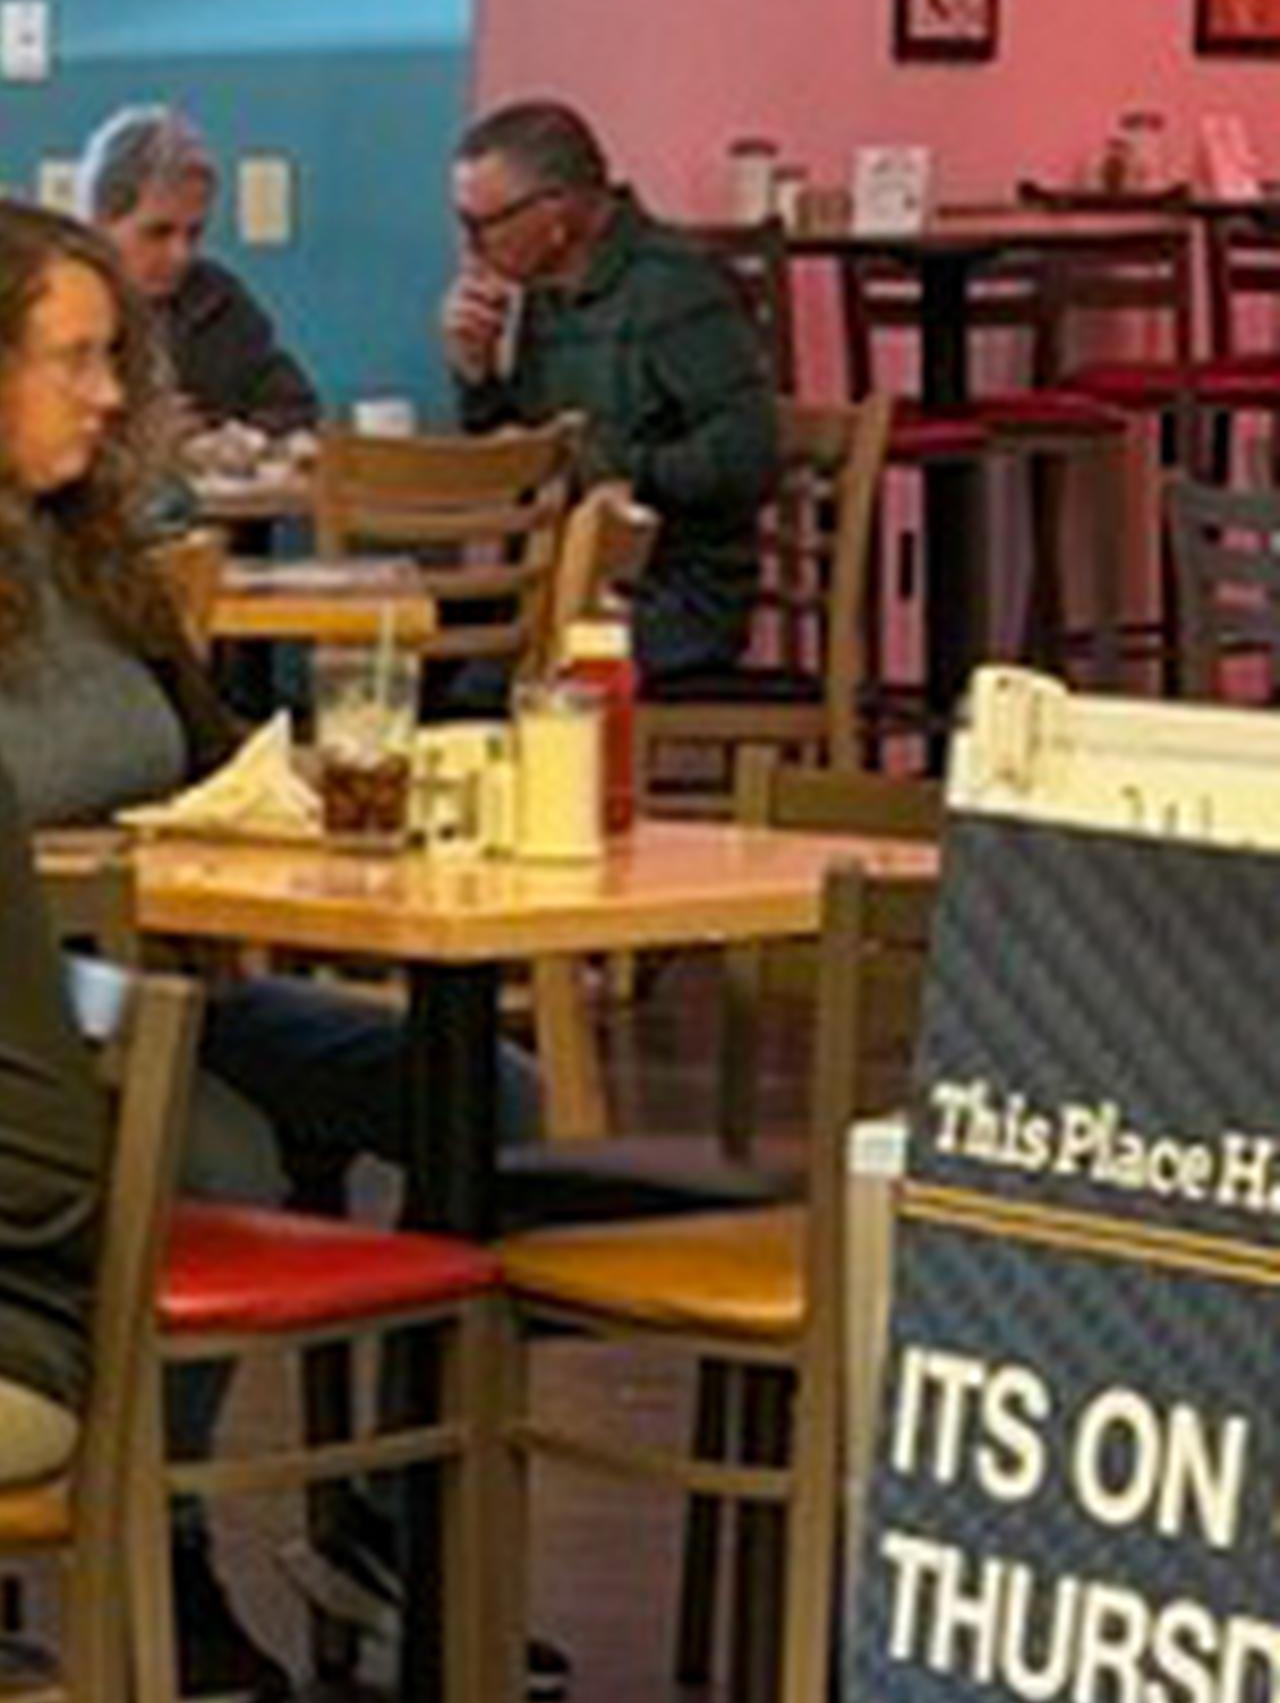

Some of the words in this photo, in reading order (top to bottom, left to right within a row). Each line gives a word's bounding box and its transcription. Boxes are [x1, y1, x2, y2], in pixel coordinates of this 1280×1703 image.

[930, 1080, 1051, 1172] This
[1054, 1100, 1213, 1199] Place
[1217, 1132, 1280, 1215] H
[892, 1346, 1051, 1501] ITS
[1074, 1387, 1248, 1547] ON
